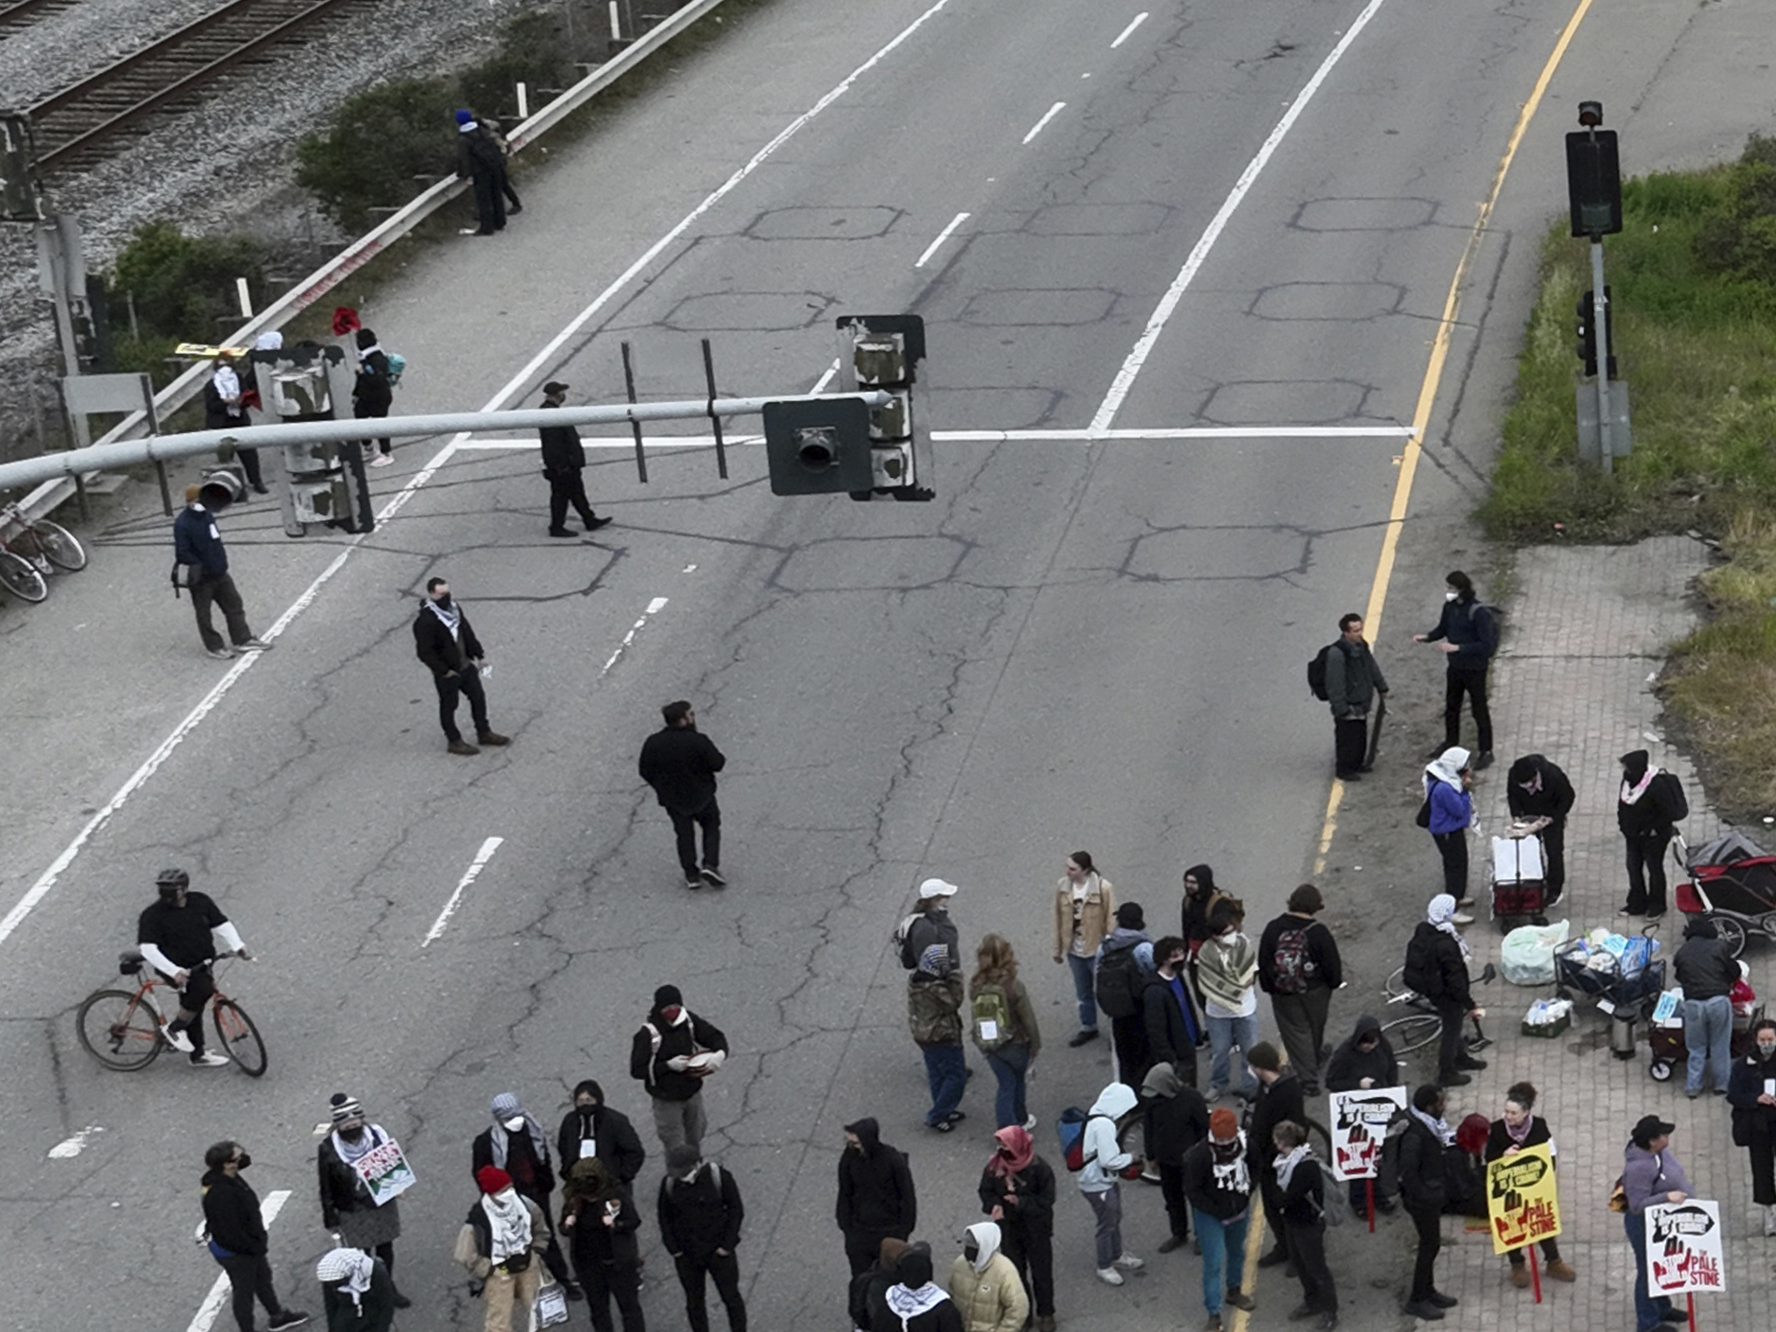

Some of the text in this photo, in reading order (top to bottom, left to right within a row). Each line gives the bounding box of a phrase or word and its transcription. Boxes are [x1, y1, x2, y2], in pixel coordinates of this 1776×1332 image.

[1528, 1201, 1553, 1223] PALE
[1529, 1218, 1558, 1238] STINE
[1690, 1256, 1718, 1271] PALE
[1689, 1271, 1721, 1287] STINE
